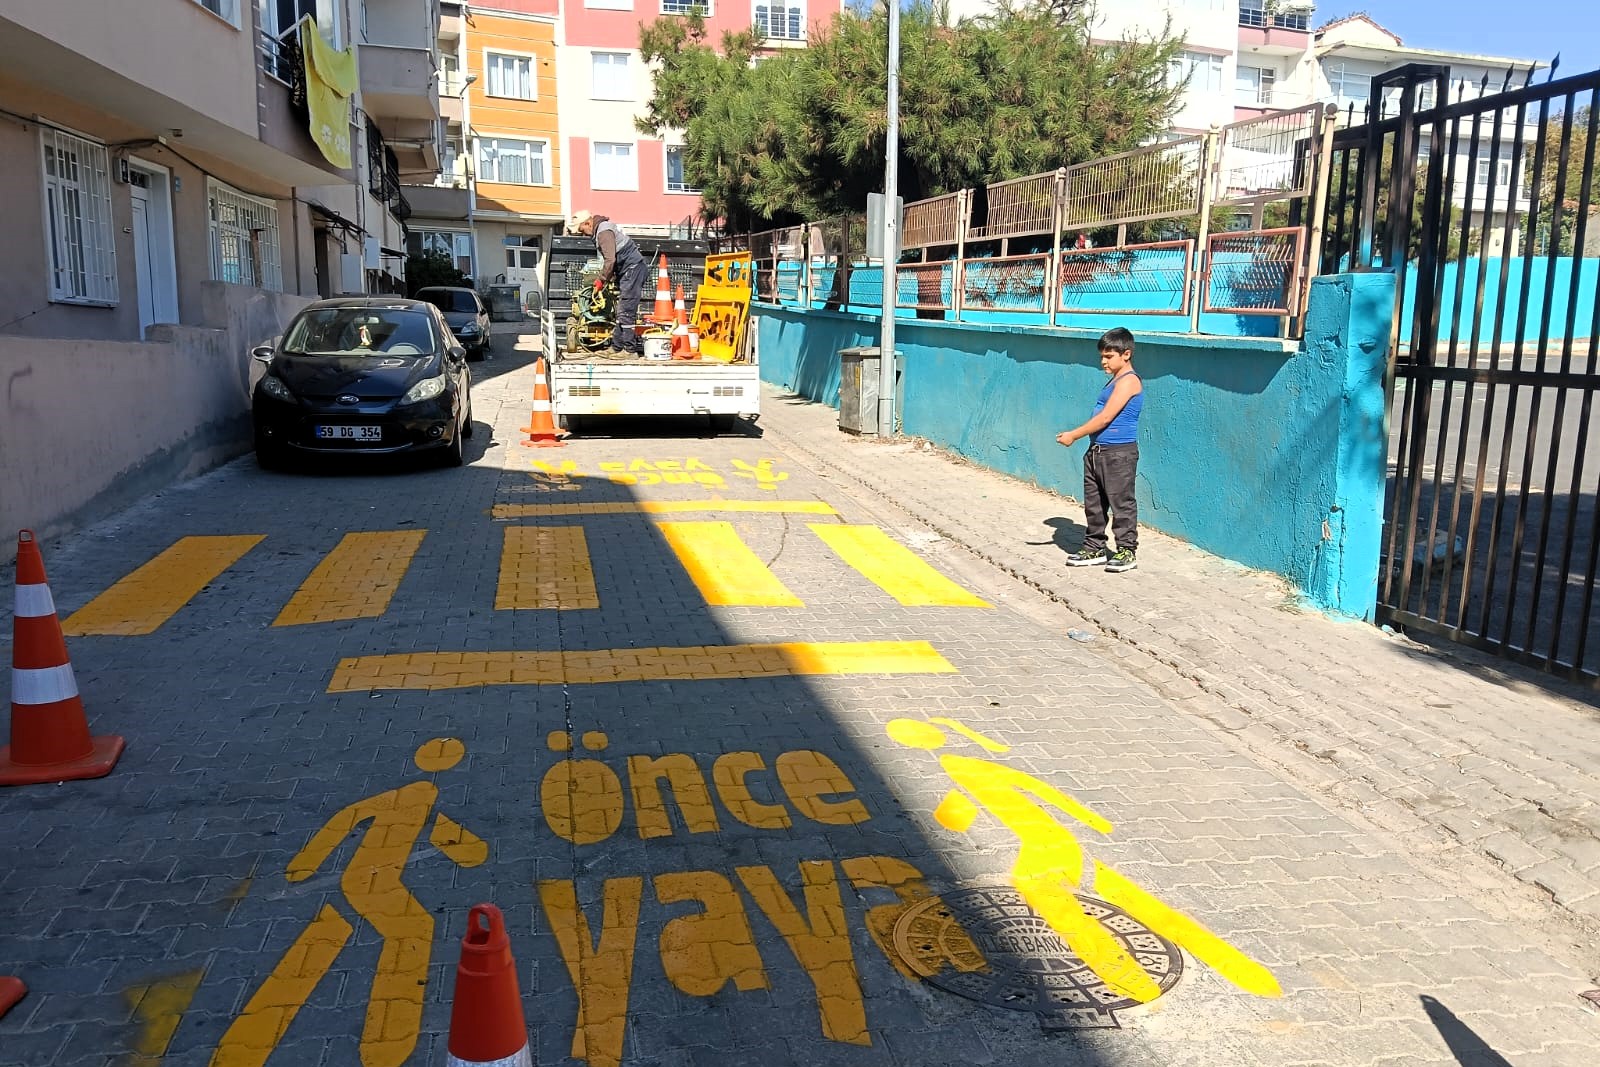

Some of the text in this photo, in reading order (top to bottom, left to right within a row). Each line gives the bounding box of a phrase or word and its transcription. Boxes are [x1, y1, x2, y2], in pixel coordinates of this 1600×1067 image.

[320, 426, 381, 438] 59 DG 354
[540, 730, 872, 845] önce
[537, 856, 988, 1067] yaya
